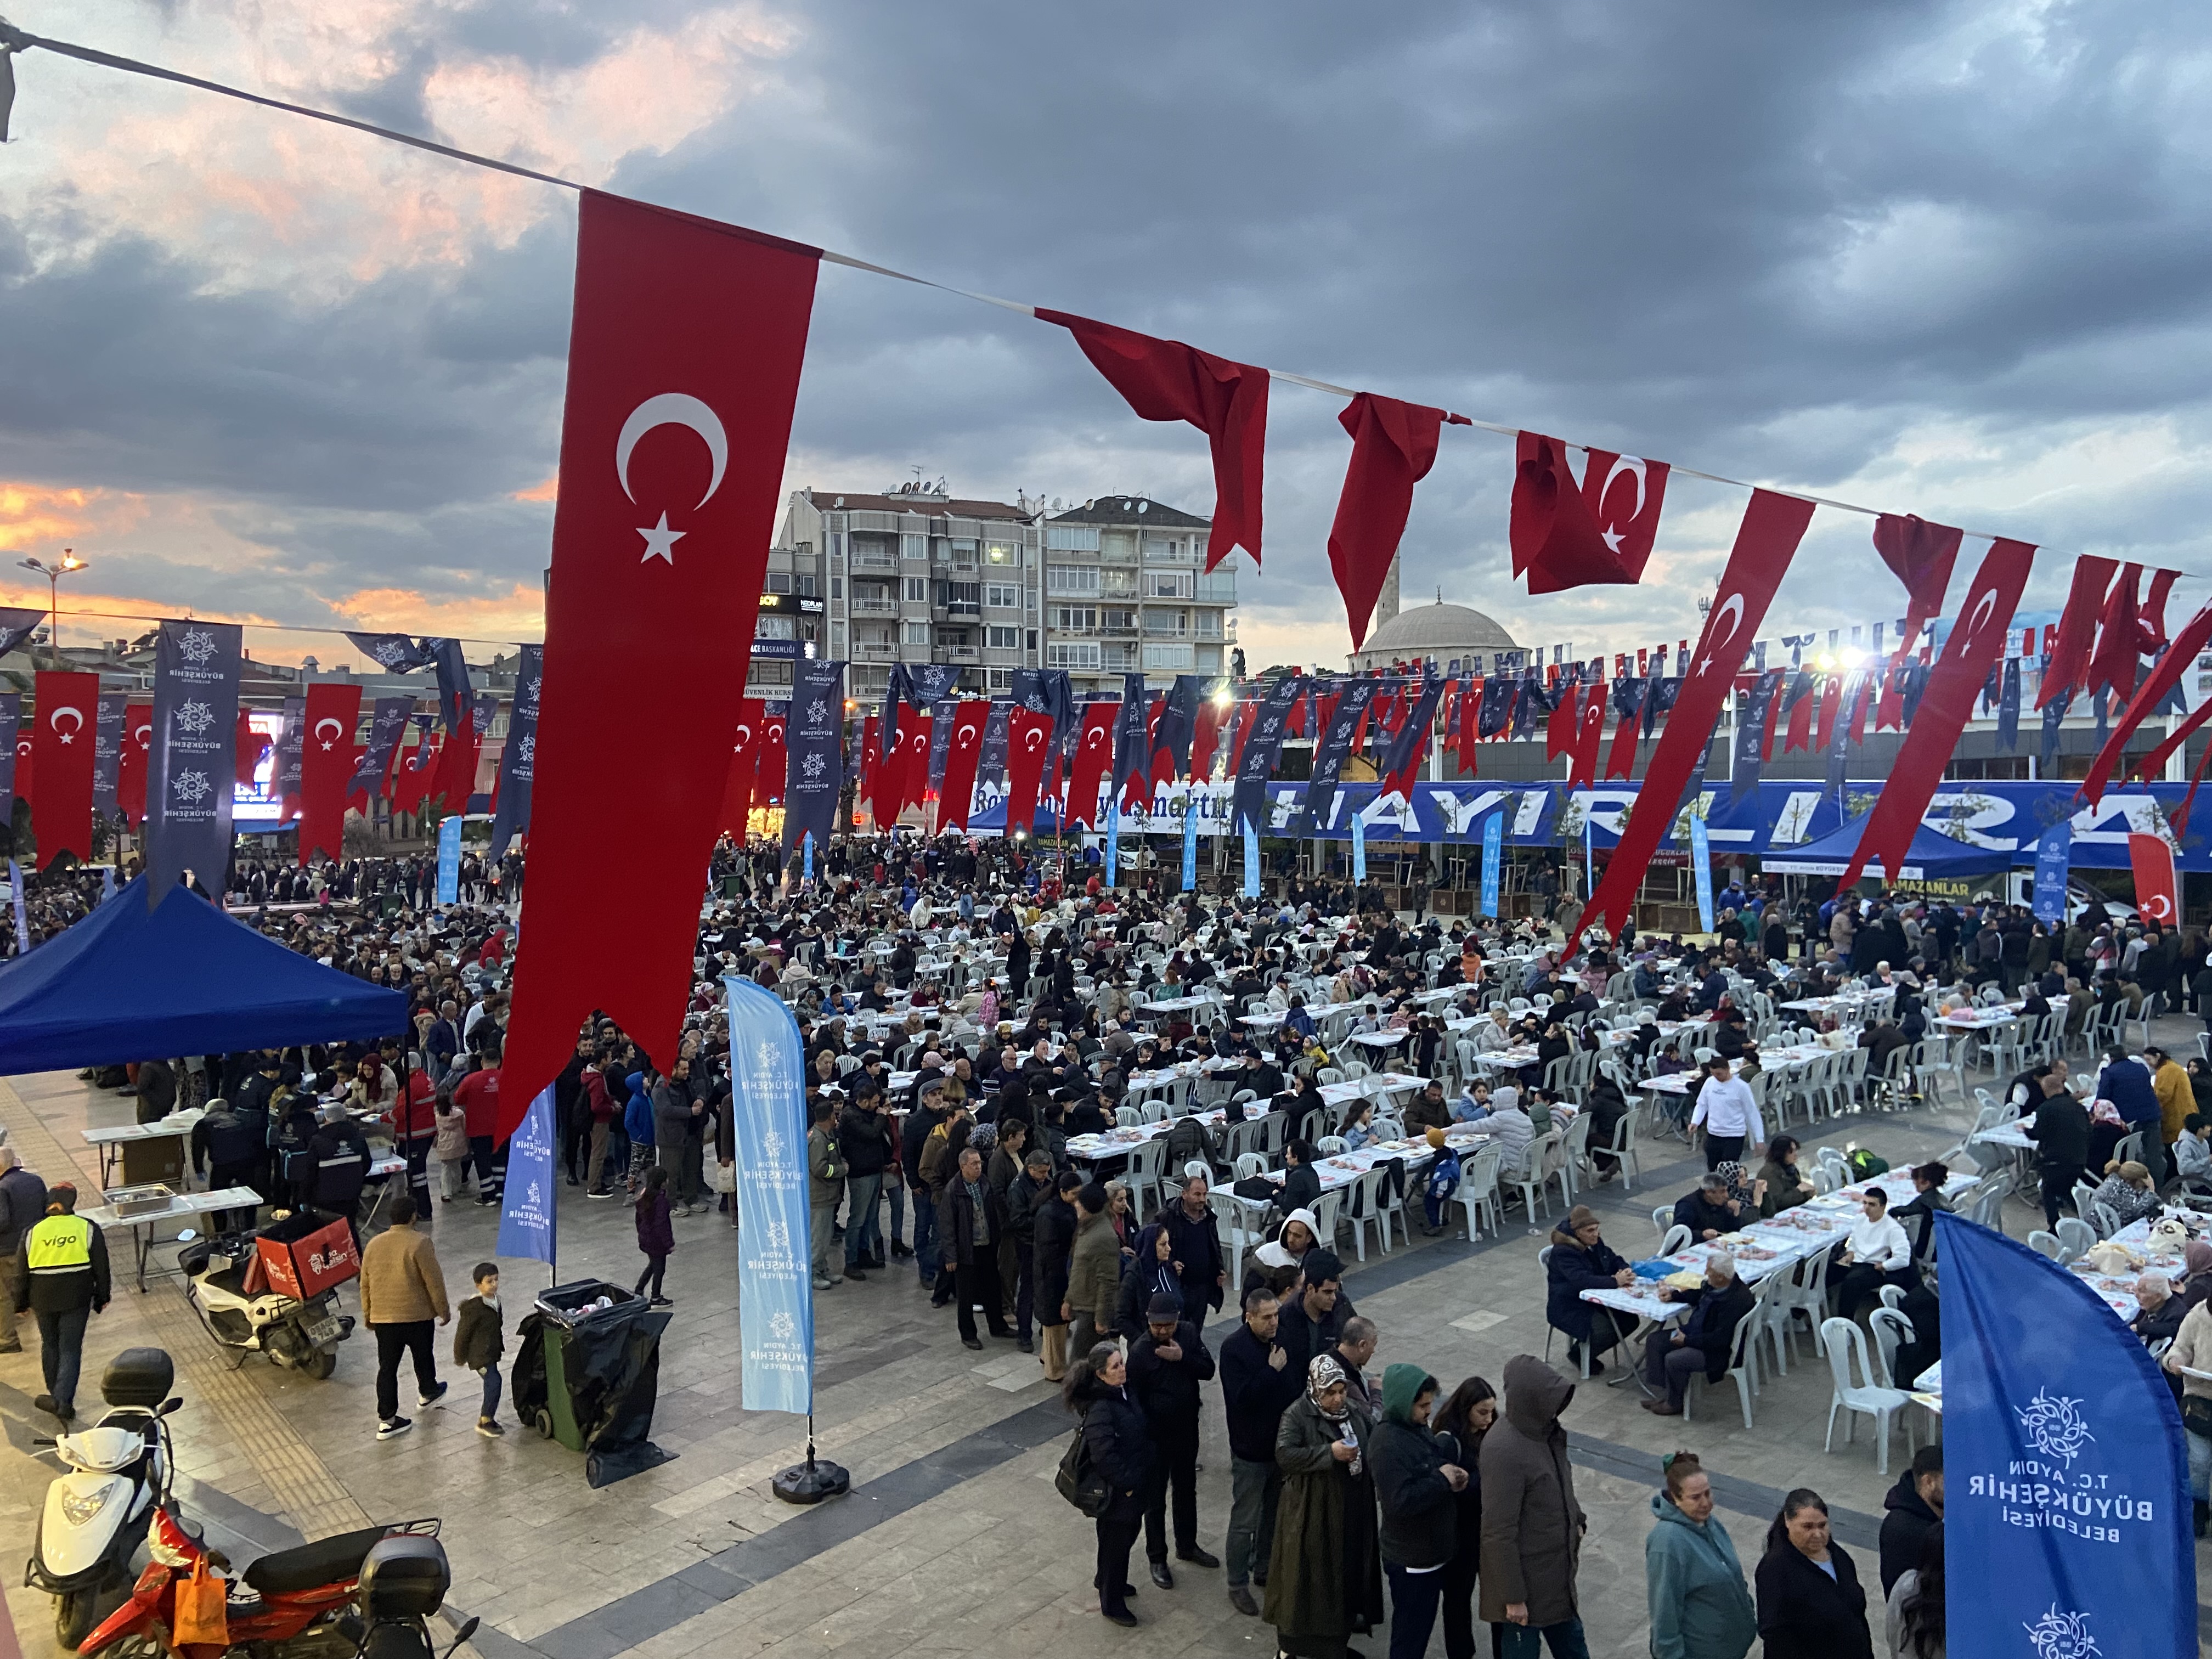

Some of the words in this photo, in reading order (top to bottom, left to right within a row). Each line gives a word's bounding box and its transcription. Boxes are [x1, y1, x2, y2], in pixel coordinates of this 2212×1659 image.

[761, 645, 795, 653] BAŞKANLIĞI
[1921, 794, 2212, 856] RA
[42, 1234, 76, 1247] vigo
